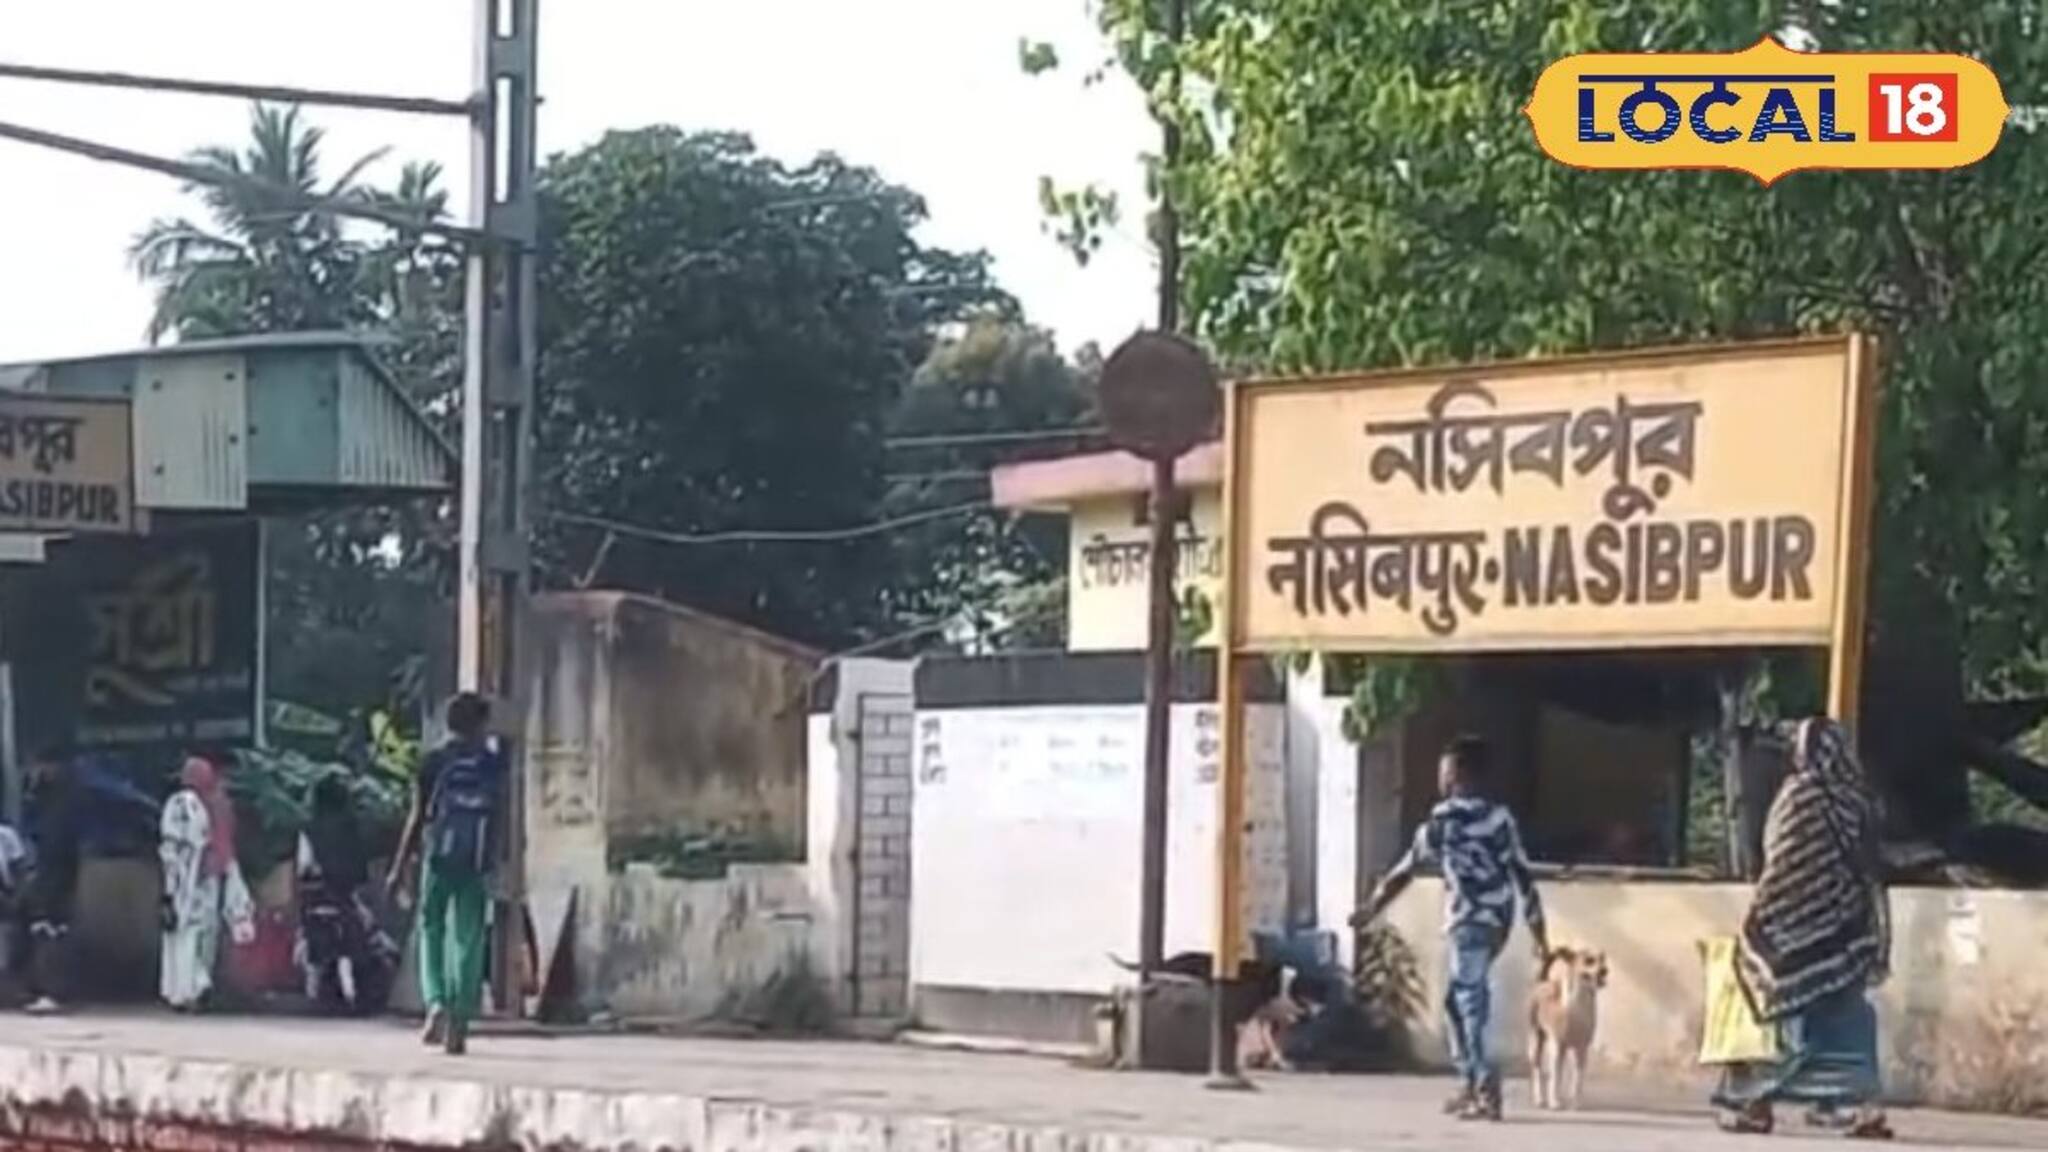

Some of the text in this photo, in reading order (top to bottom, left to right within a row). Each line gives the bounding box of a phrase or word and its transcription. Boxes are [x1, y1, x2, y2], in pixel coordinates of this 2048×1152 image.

[1366, 382, 1703, 521] নসিবপুর
[0, 479, 119, 523] SIBPUR
[1503, 515, 1815, 606] NASIBPUR
